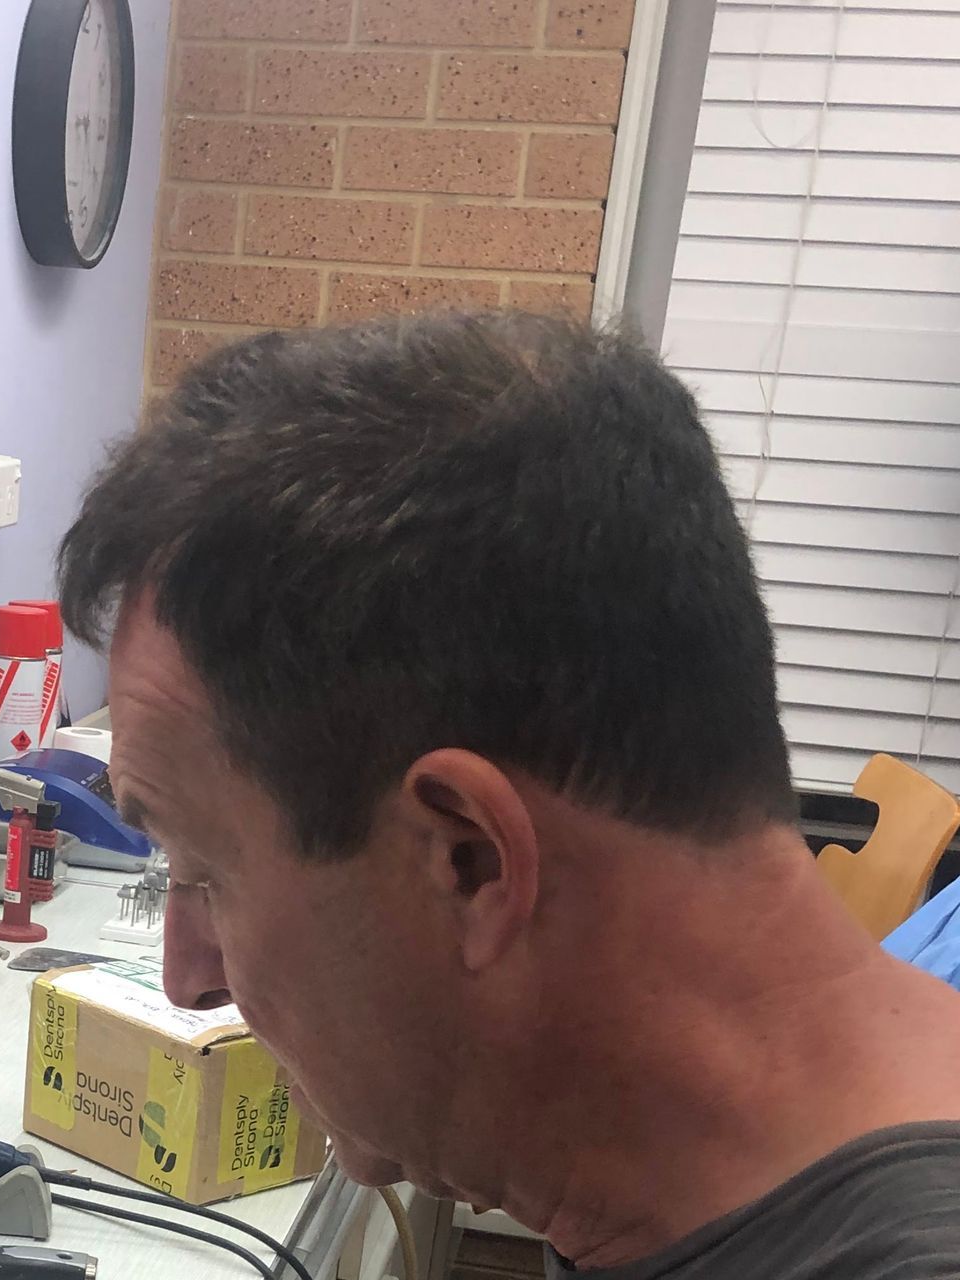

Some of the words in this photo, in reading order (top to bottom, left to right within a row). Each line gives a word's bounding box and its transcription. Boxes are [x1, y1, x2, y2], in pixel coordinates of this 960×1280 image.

[43, 985, 57, 1058] Dentsply
[54, 1005, 65, 1061] Sirona
[76, 1071, 134, 1112] Sirona
[231, 1094, 249, 1171] Dentsply
[243, 1109, 258, 1167] Sirona
